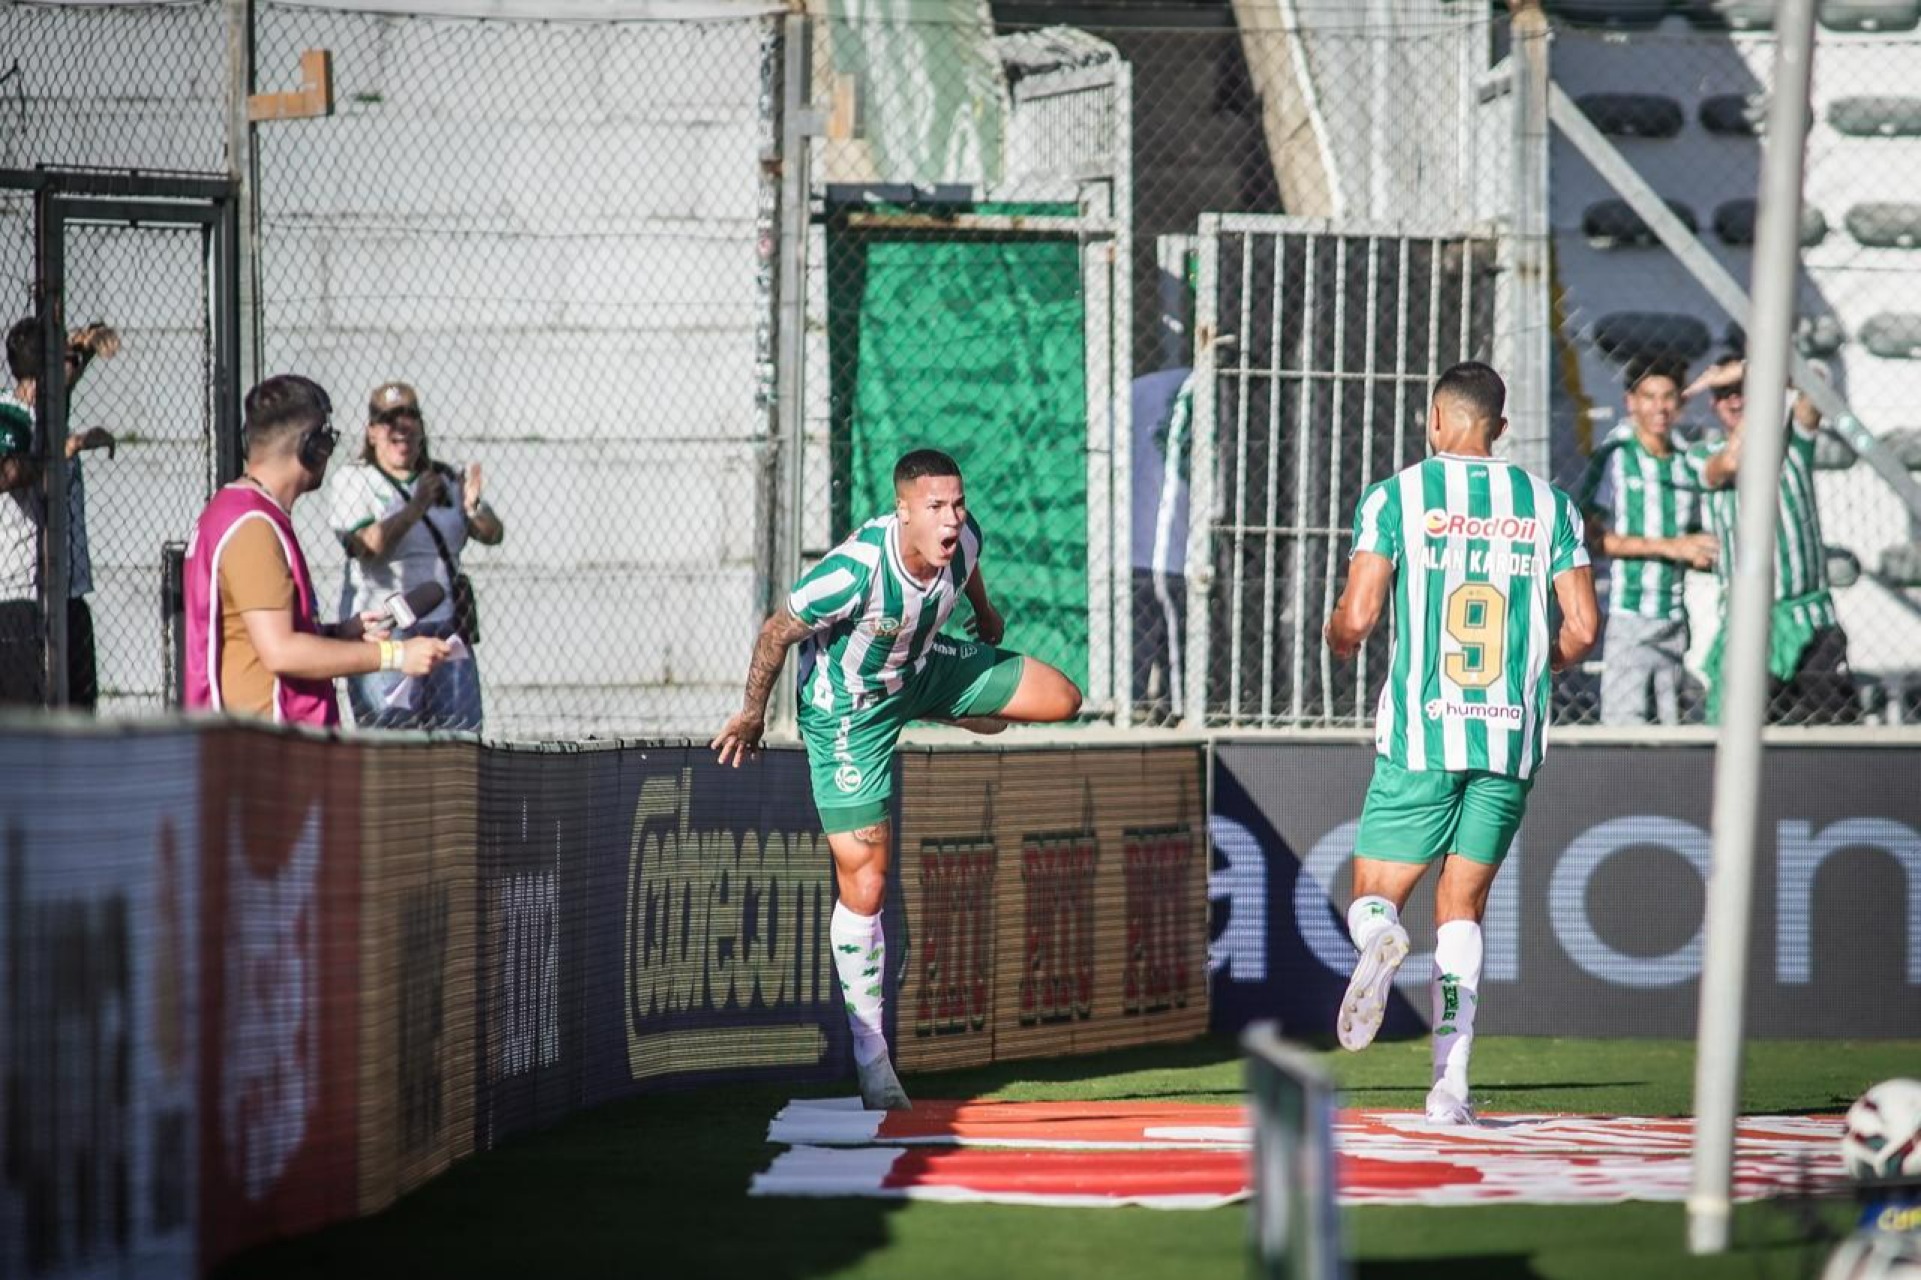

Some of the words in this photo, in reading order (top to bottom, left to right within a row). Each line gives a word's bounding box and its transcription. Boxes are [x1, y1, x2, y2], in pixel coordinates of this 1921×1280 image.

[1448, 514, 1537, 541] RodOil
[1421, 546, 1464, 571] ALAN
[1444, 582, 1506, 689] 9
[1445, 701, 1521, 721] humana
